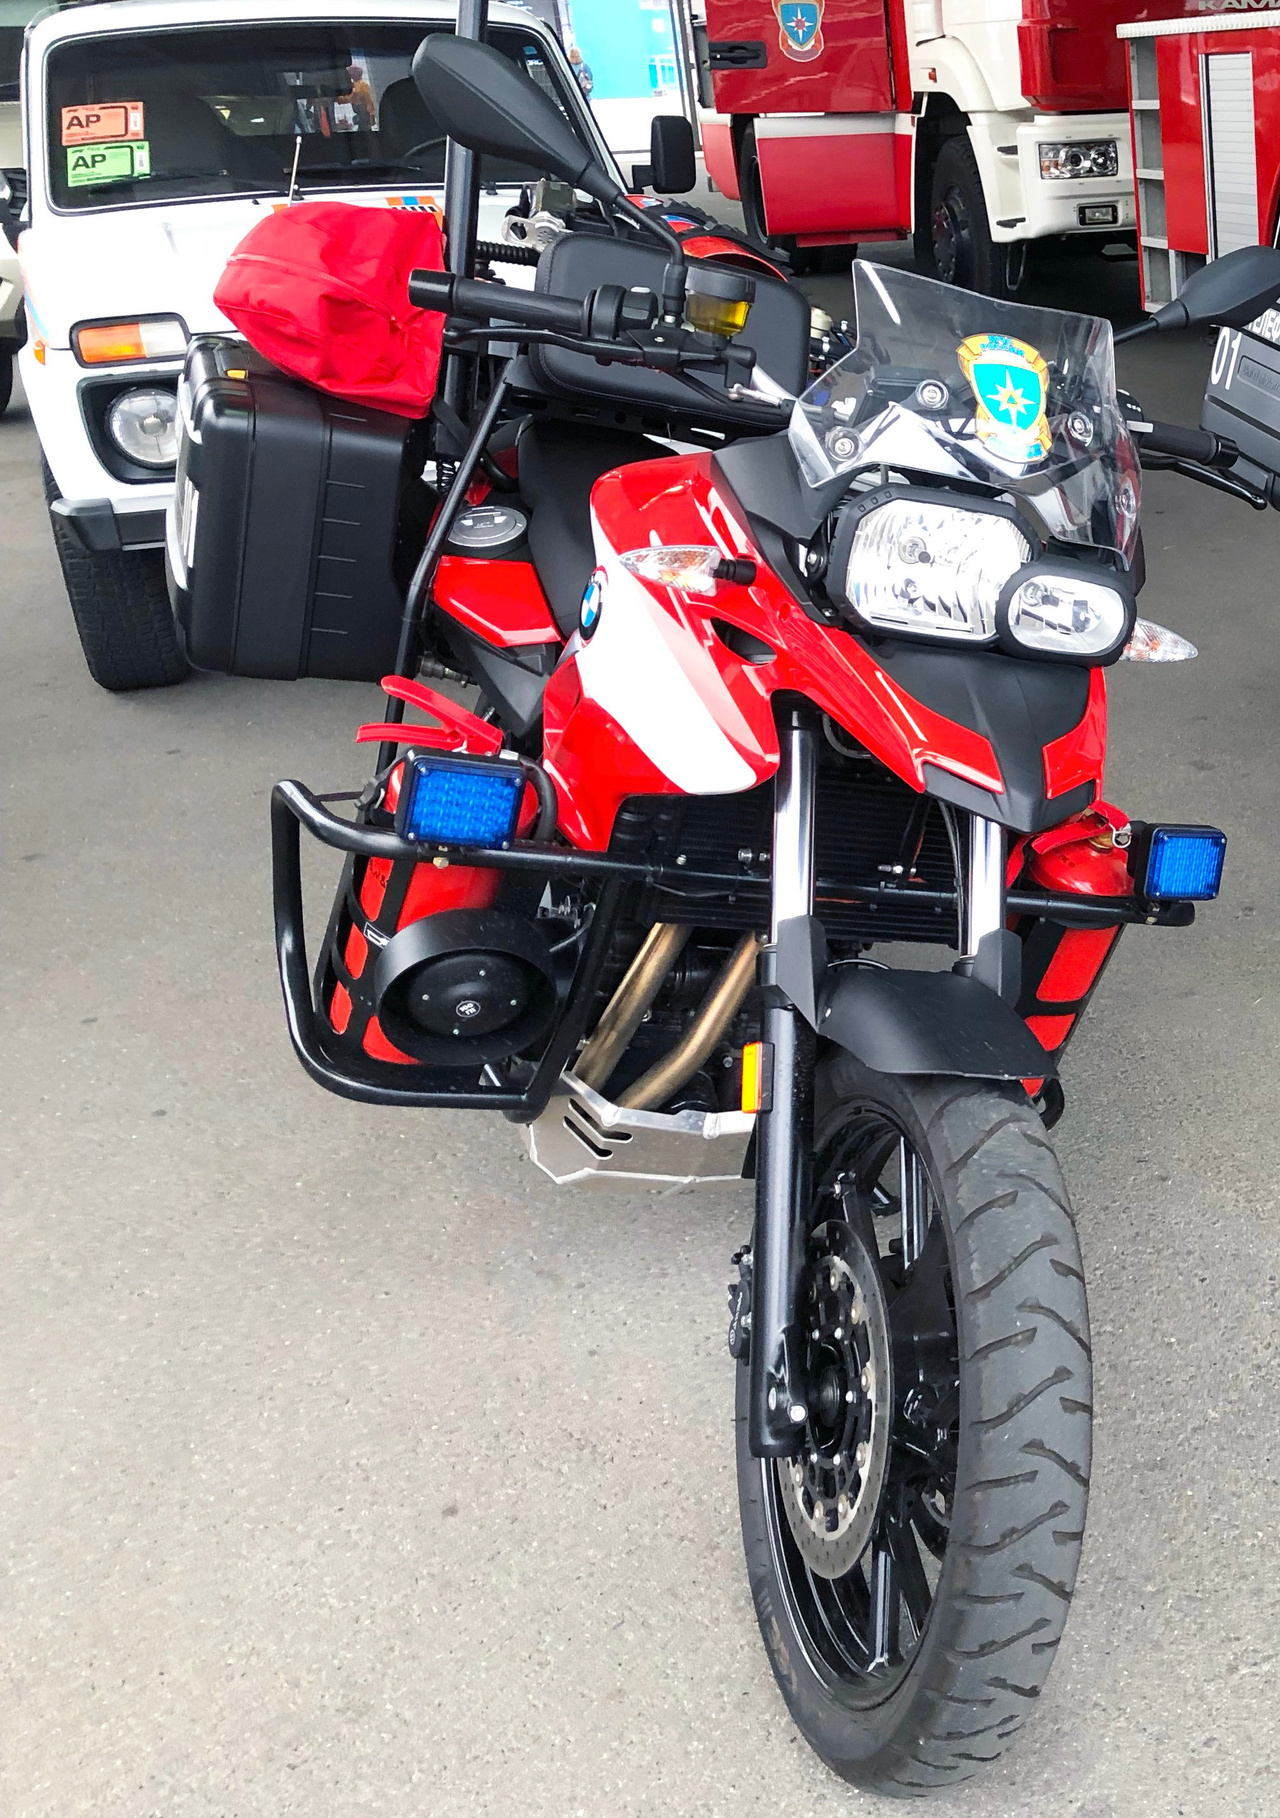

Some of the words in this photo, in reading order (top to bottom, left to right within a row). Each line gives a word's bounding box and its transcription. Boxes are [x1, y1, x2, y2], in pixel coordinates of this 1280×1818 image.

[66, 114, 101, 130] AP
[71, 153, 107, 171] AP
[1210, 326, 1242, 390] 01
